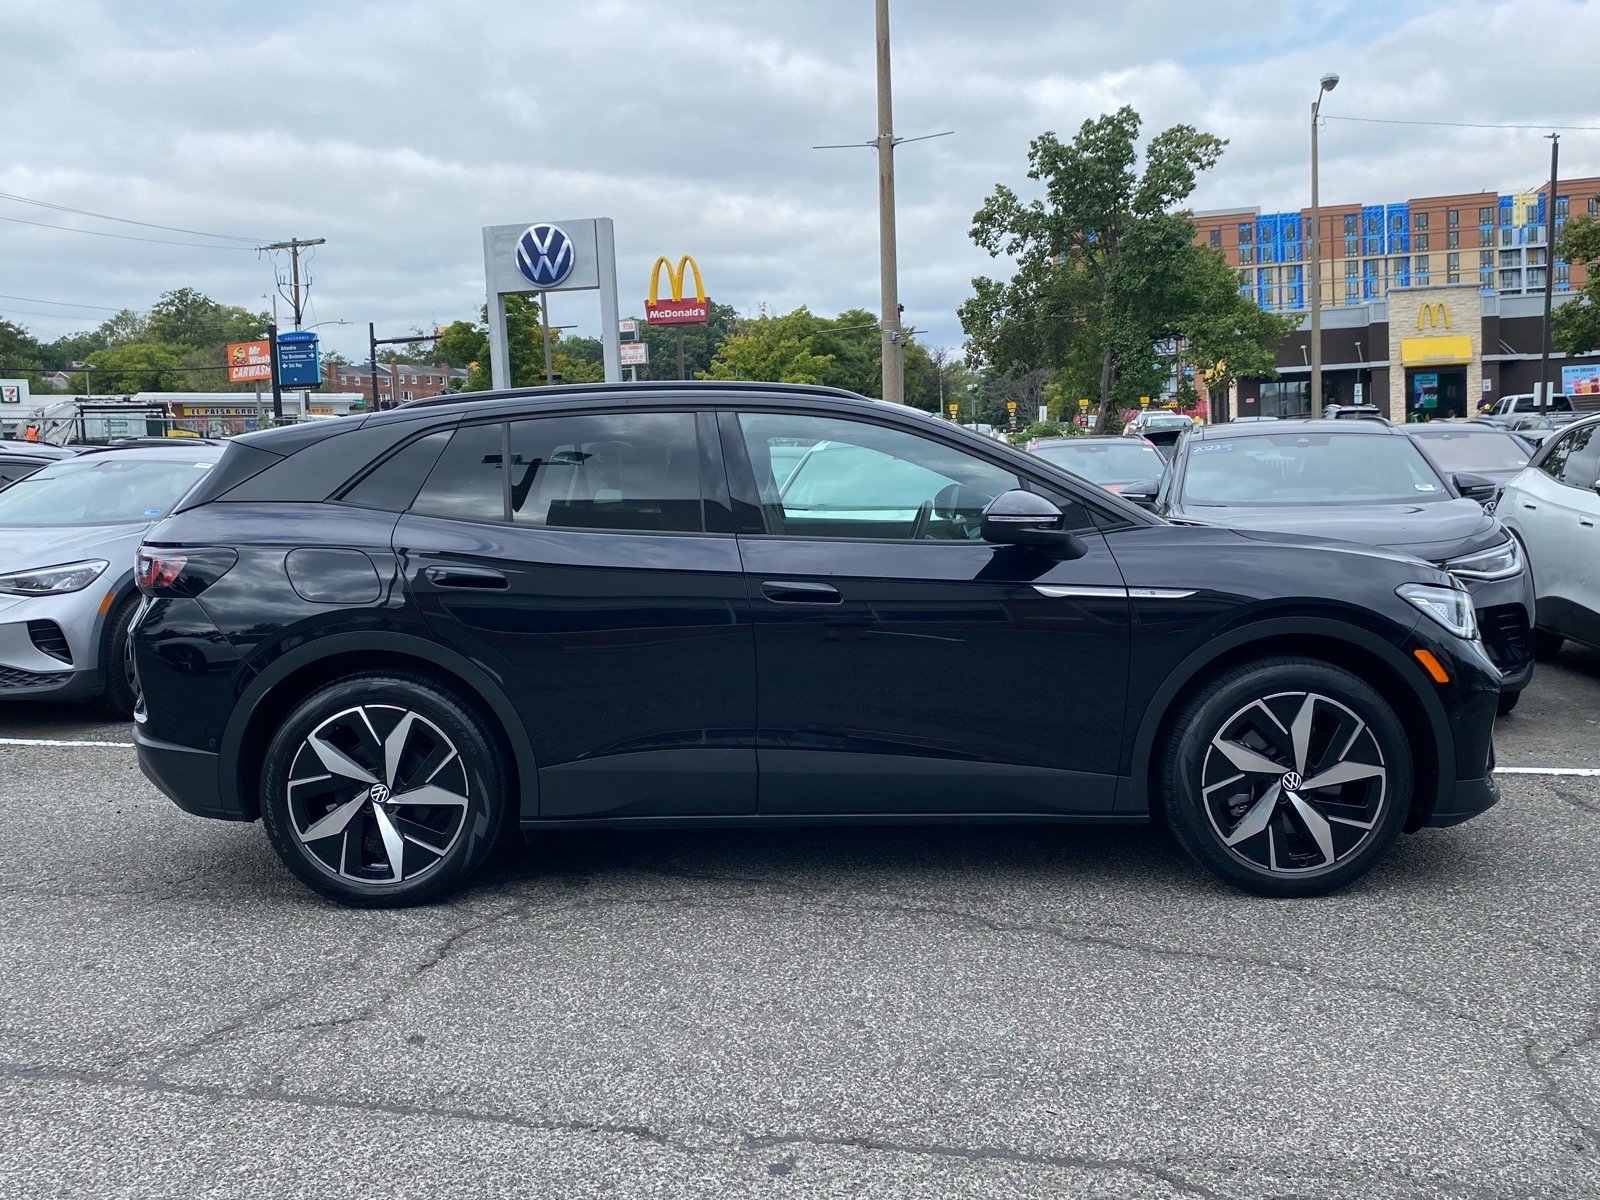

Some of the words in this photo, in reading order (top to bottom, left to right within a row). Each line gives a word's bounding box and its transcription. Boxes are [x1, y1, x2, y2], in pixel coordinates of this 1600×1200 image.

[515, 224, 575, 287] VW
[650, 308, 705, 318] McDonald's
[249, 346, 260, 355] Mr
[249, 354, 271, 365] Wash
[232, 365, 271, 379] CARWASH
